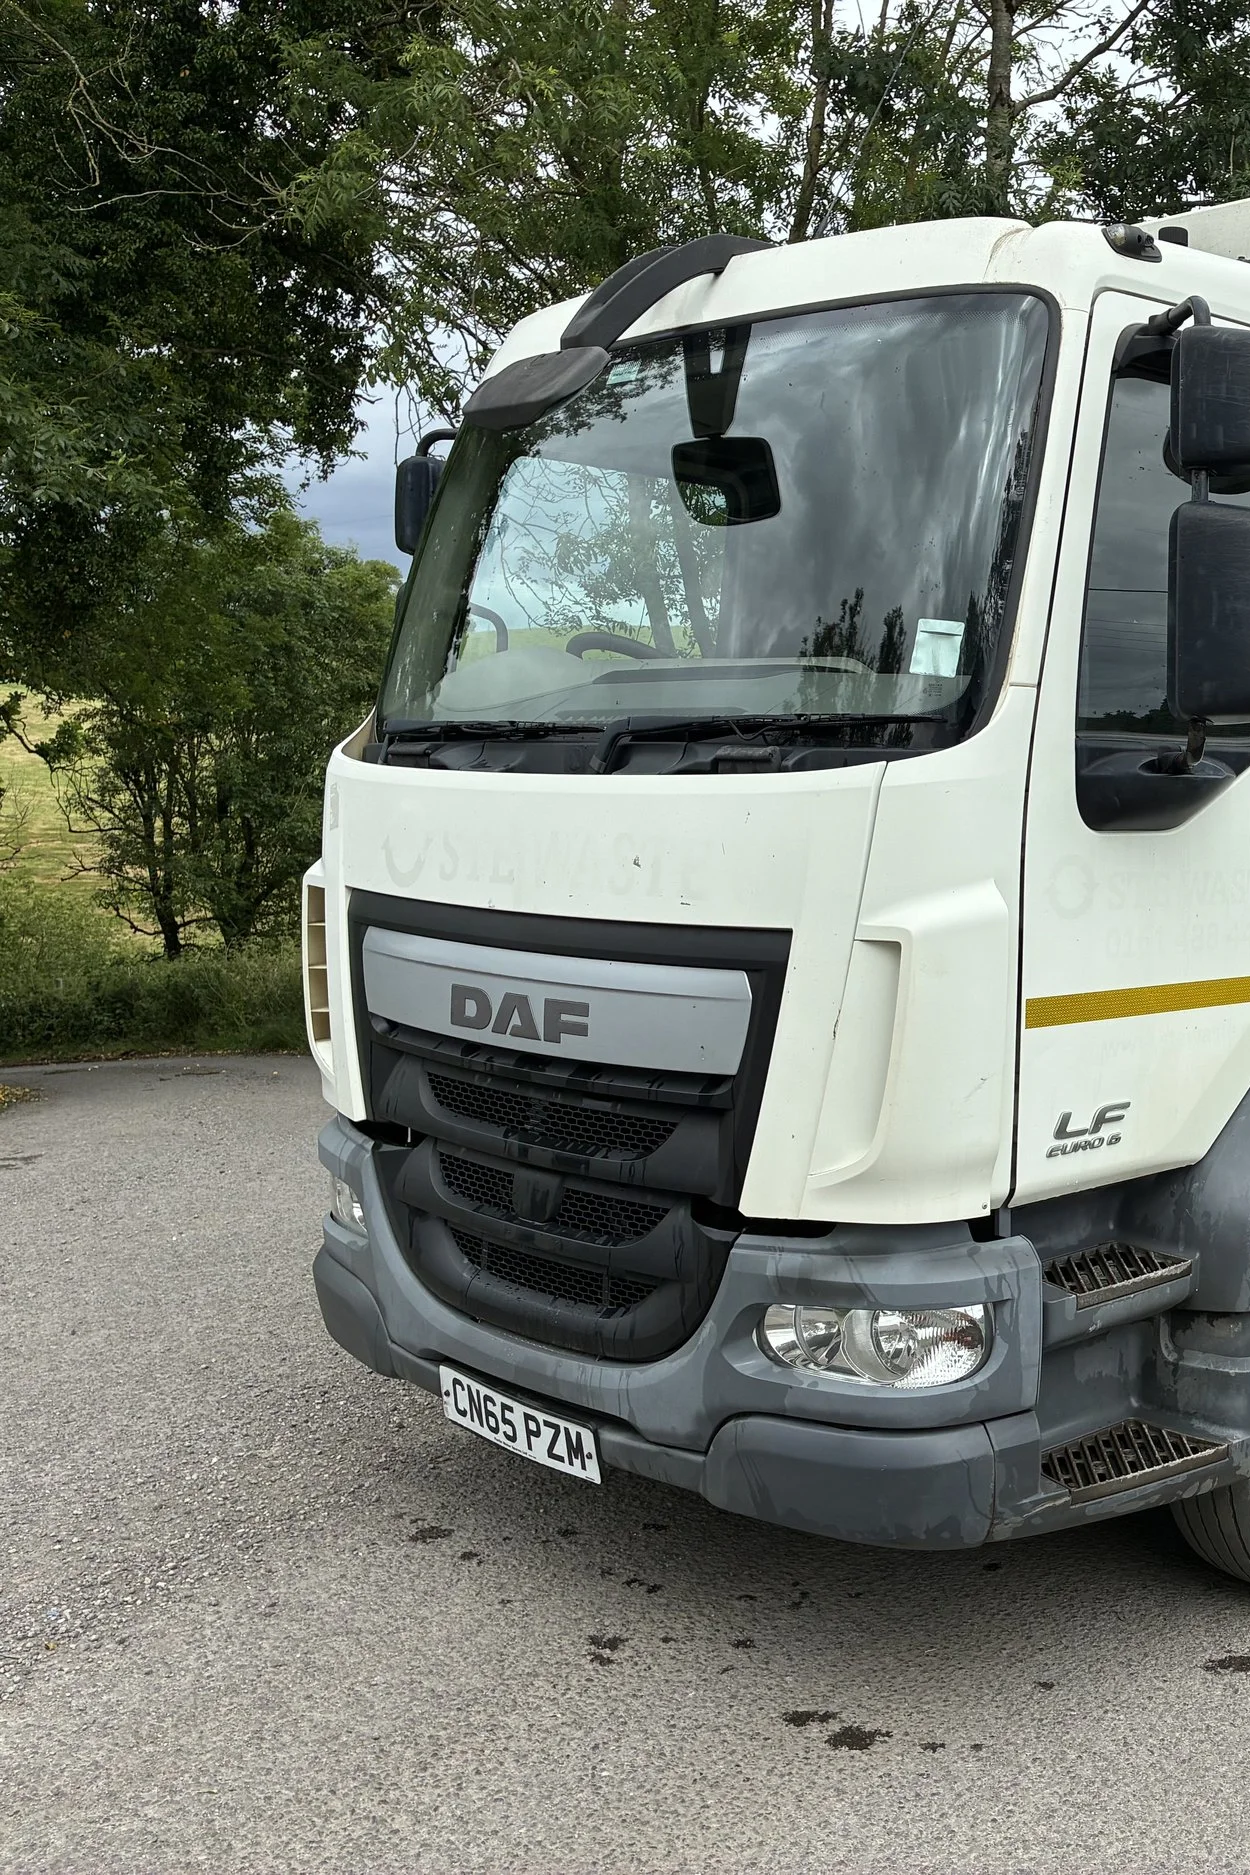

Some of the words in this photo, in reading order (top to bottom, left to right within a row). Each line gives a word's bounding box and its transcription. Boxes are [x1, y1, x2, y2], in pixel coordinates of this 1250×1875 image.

[450, 983, 590, 1044] DAF
[1046, 1136, 1105, 1158] EURO
[1106, 1132, 1122, 1146] 6
[1052, 1101, 1131, 1140] LF
[452, 1377, 517, 1444] CN65
[523, 1411, 587, 1471] PZM
